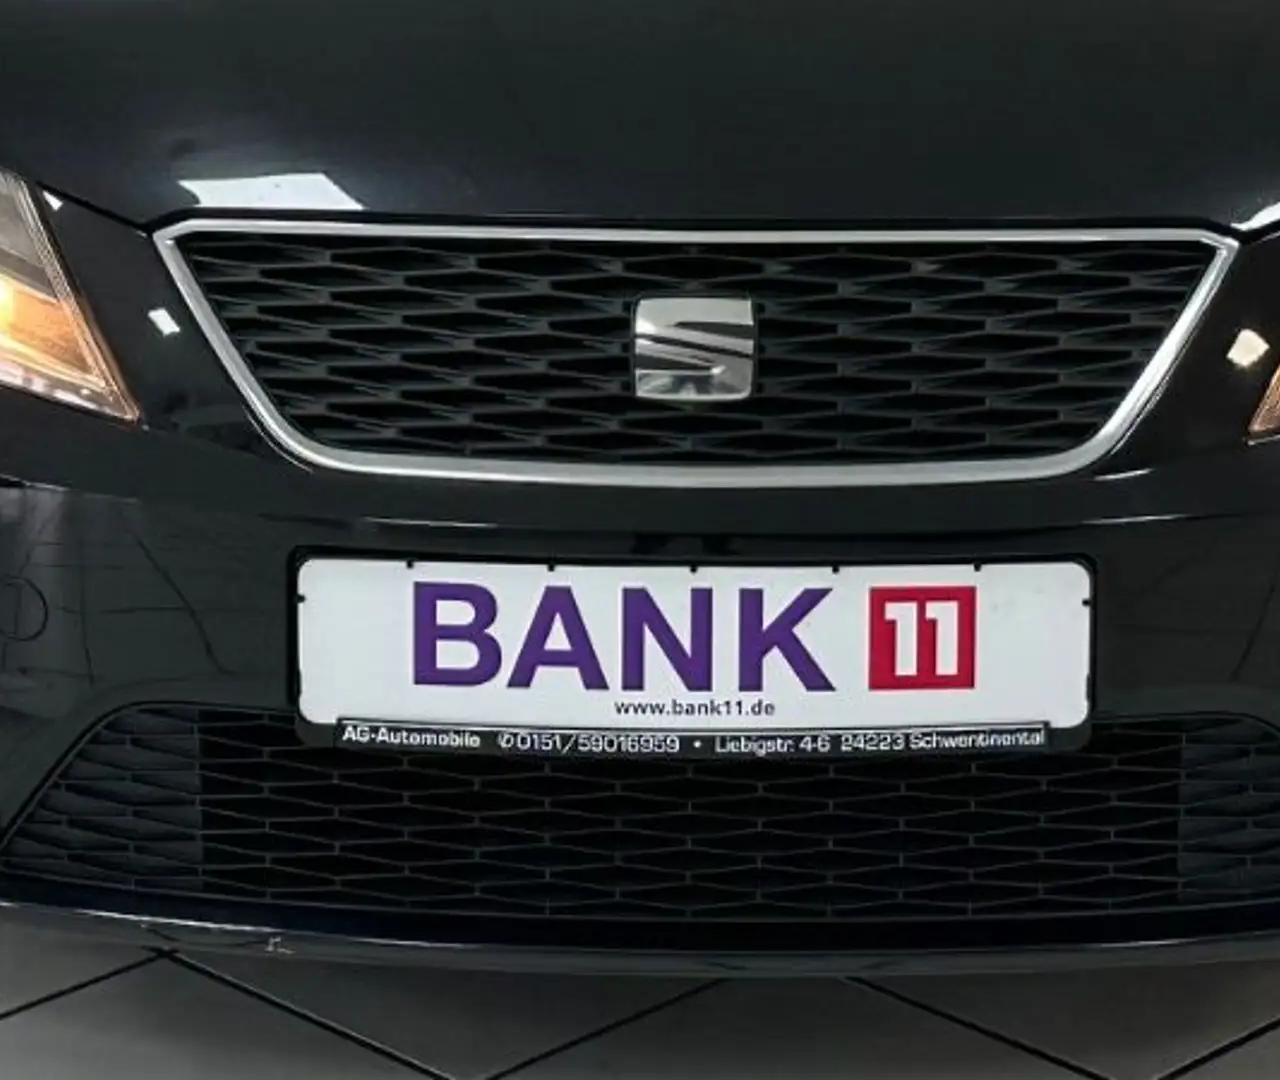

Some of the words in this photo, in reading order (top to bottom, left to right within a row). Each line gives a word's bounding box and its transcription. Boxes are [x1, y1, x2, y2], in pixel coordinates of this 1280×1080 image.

[413, 580, 837, 692] BANK
[880, 596, 963, 680] 11
[613, 698, 776, 717] www.bank11.de
[342, 725, 482, 749] AG-Automobile
[841, 732, 904, 752] 24223
